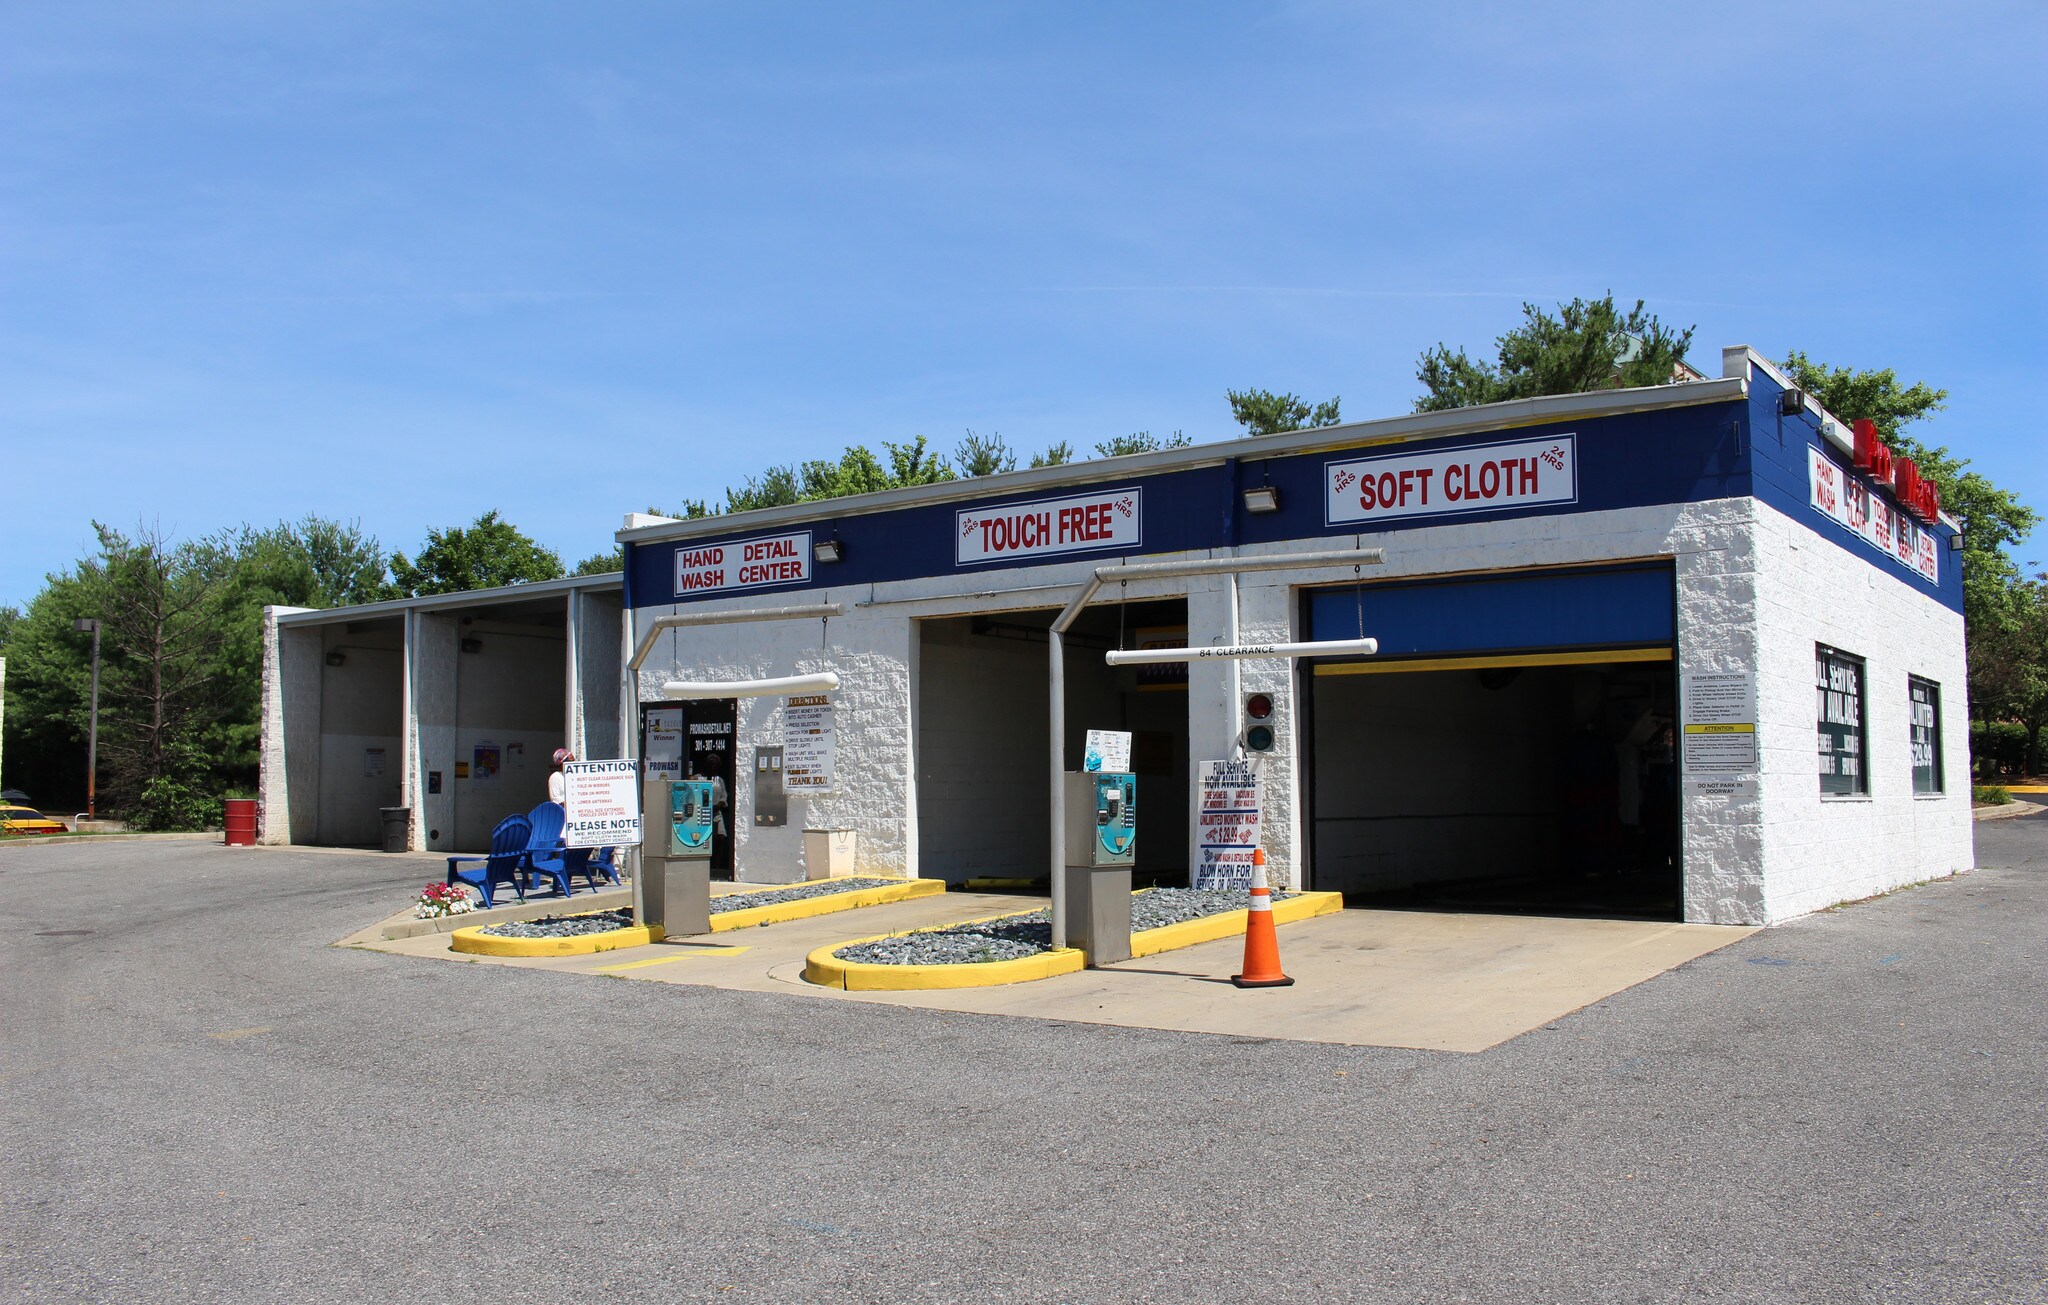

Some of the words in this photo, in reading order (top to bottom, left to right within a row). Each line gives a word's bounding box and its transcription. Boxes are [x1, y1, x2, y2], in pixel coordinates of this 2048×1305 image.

[1551, 445, 1565, 459] 24
[1540, 450, 1564, 471] HRS
[1334, 469, 1347, 483] 24
[1816, 456, 1833, 486] HAND
[1334, 472, 1356, 494] HRS
[1359, 468, 1433, 511] SOFT
[1443, 457, 1538, 501] CLOTH
[1122, 496, 1133, 507] 24
[1817, 480, 1836, 514] WASH
[1114, 500, 1132, 518] HRS
[962, 517, 972, 528] 24
[962, 520, 979, 538] HRS
[980, 512, 1050, 552] TOUCH
[1058, 503, 1113, 544] FREE
[1875, 522, 1890, 550] FREE
[683, 548, 724, 569] HAND
[744, 540, 798, 562] DETAIL
[681, 570, 724, 590] WASH
[739, 561, 802, 583] CENTER
[1216, 646, 1275, 656] CLEARANCE
[788, 695, 829, 706] DIRECTIONS
[566, 762, 636, 774] ATTENTION
[650, 762, 678, 771] PROWASH
[1213, 762, 1225, 775] FULL
[1226, 761, 1248, 775] SERVICE
[788, 777, 811, 785] THANK
[813, 776, 828, 784] YOU!
[1205, 776, 1220, 789] NOW
[568, 820, 607, 831] PLEASE
[611, 819, 639, 829] NOTE
[1200, 814, 1223, 825] UNLIMITED
[1224, 814, 1244, 825] MONTHLY
[1245, 814, 1258, 824] WASH
[1200, 864, 1216, 877] BLOW
[1217, 864, 1234, 877] HORN
[1236, 865, 1250, 877] FOR
[1196, 878, 1214, 890] SERVICE
[1218, 879, 1224, 890] OR
